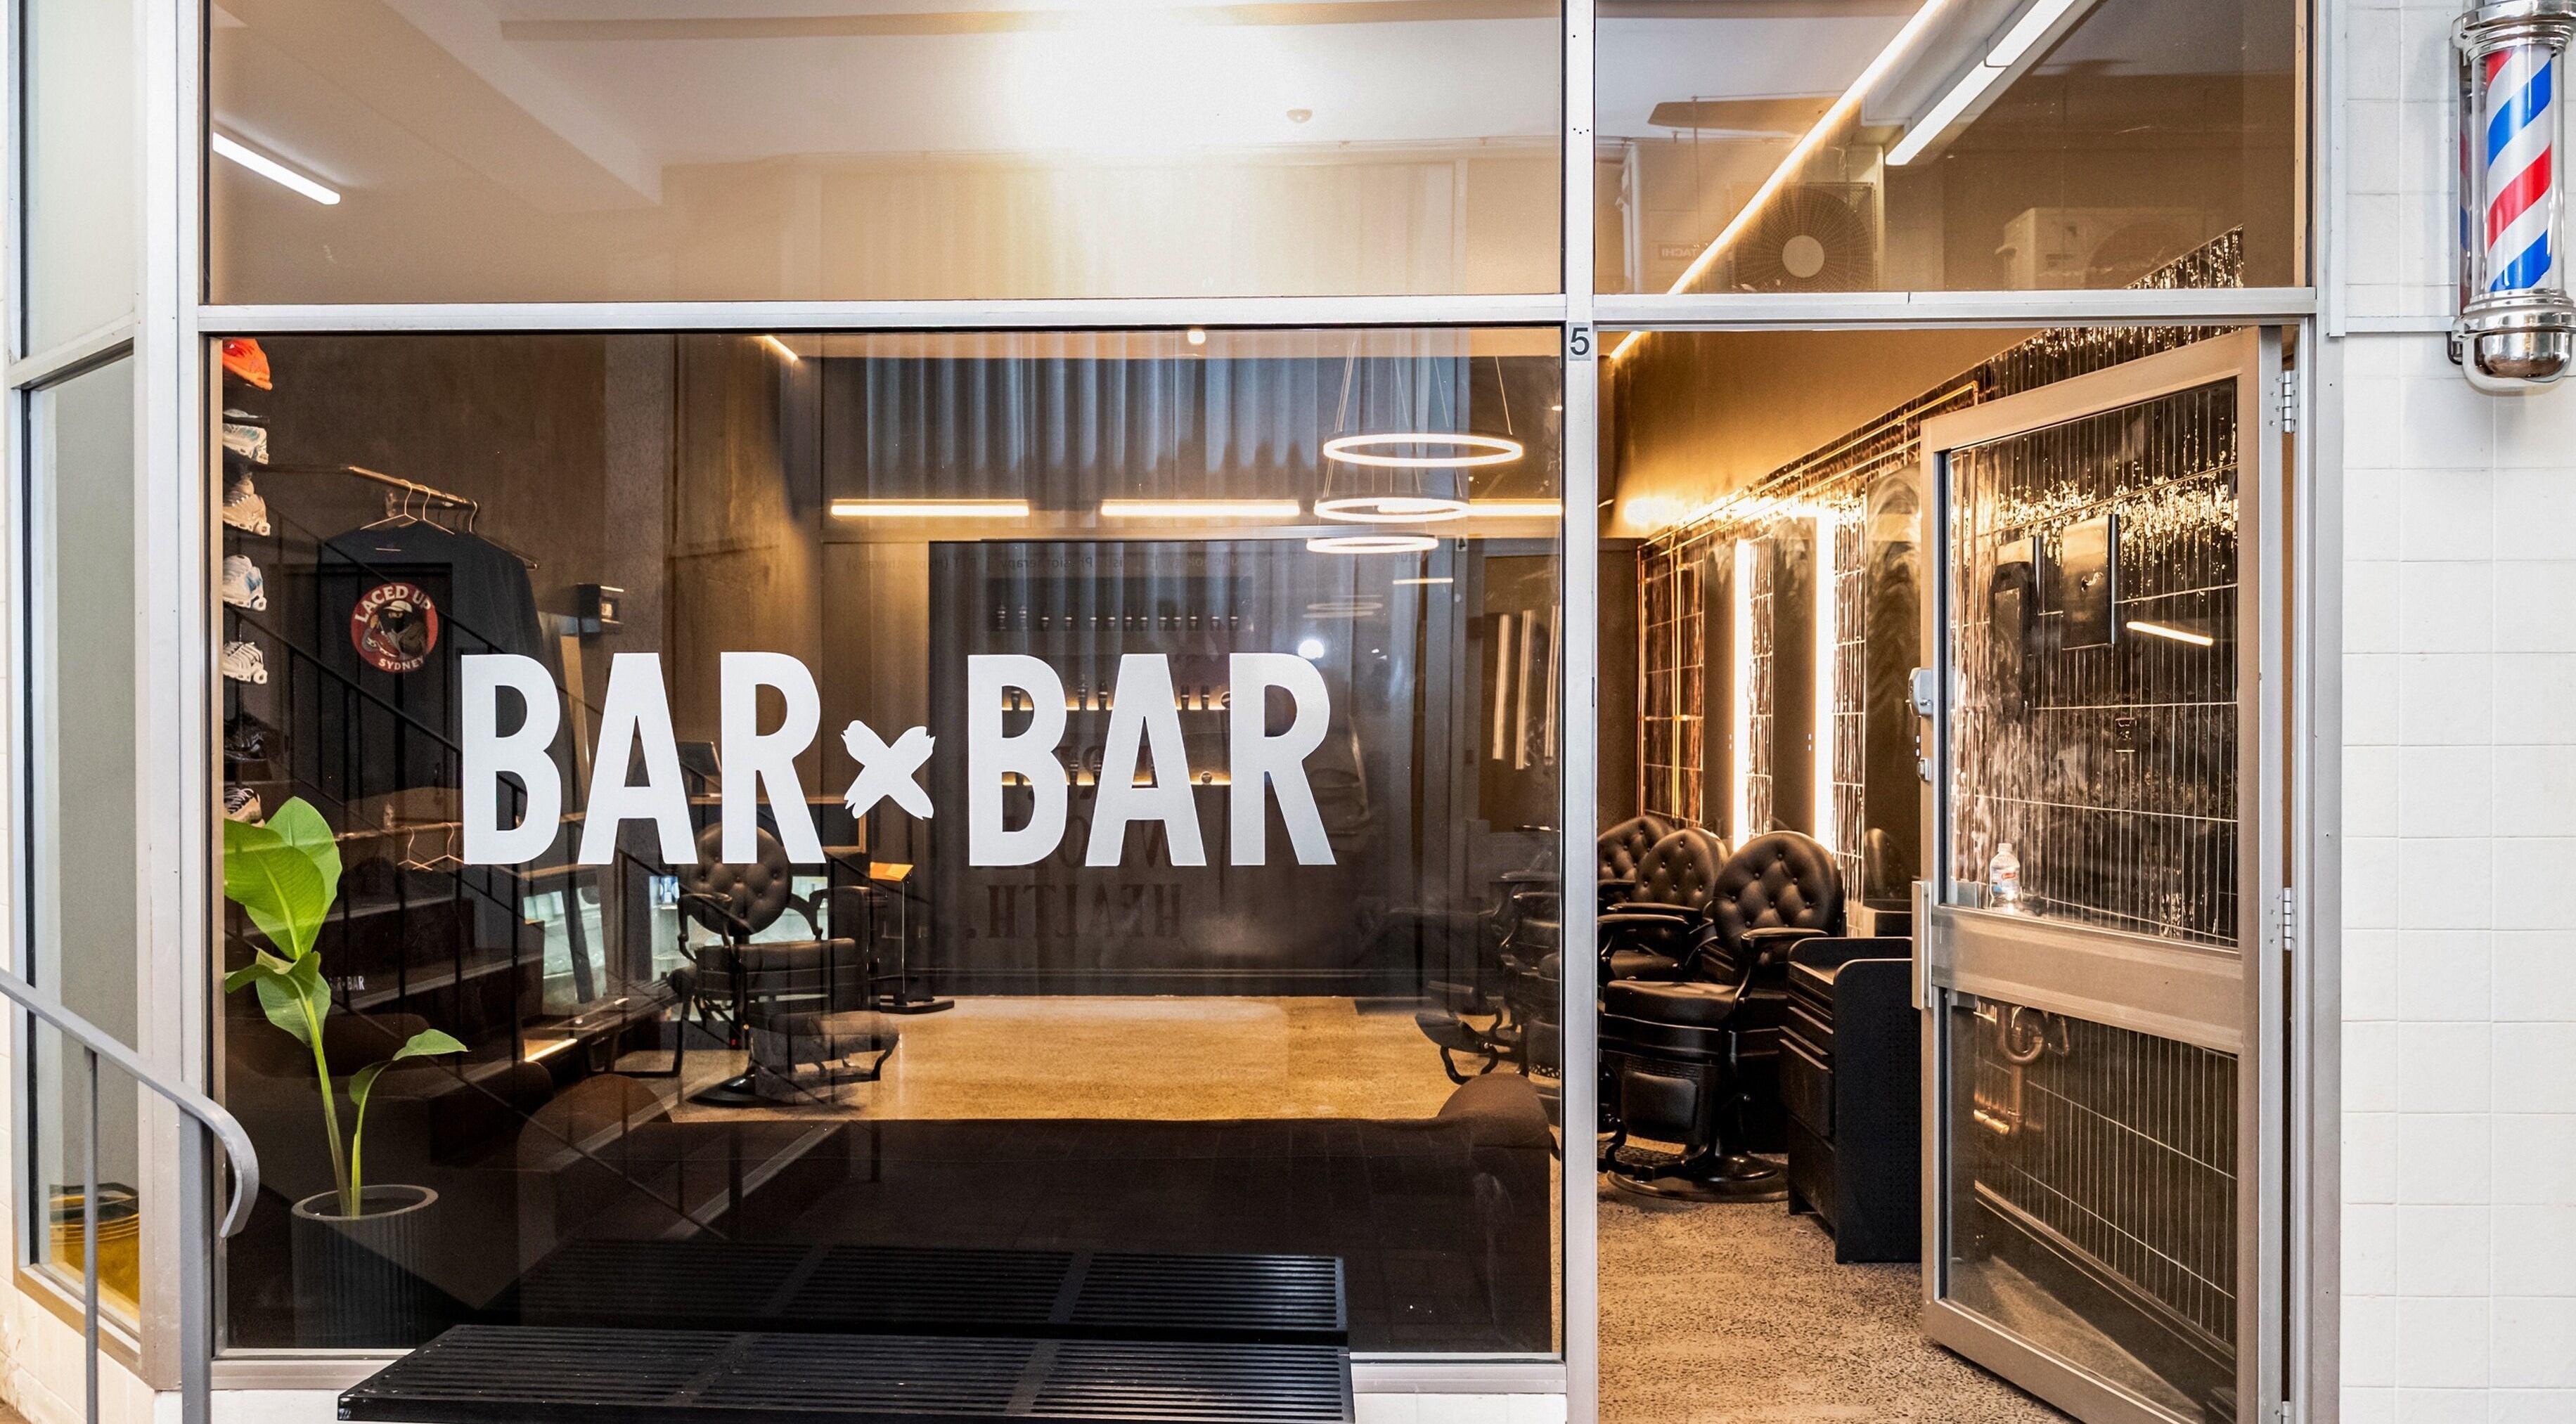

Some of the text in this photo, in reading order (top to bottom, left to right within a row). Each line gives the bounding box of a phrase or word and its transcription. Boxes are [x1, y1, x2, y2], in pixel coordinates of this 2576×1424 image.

[1570, 327, 1590, 356] 5
[354, 585, 431, 623] LACED UP
[378, 655, 424, 671] SYDNEY
[461, 652, 827, 865] BAR
[967, 652, 1337, 867] BAR
[347, 976, 365, 991] BAR
